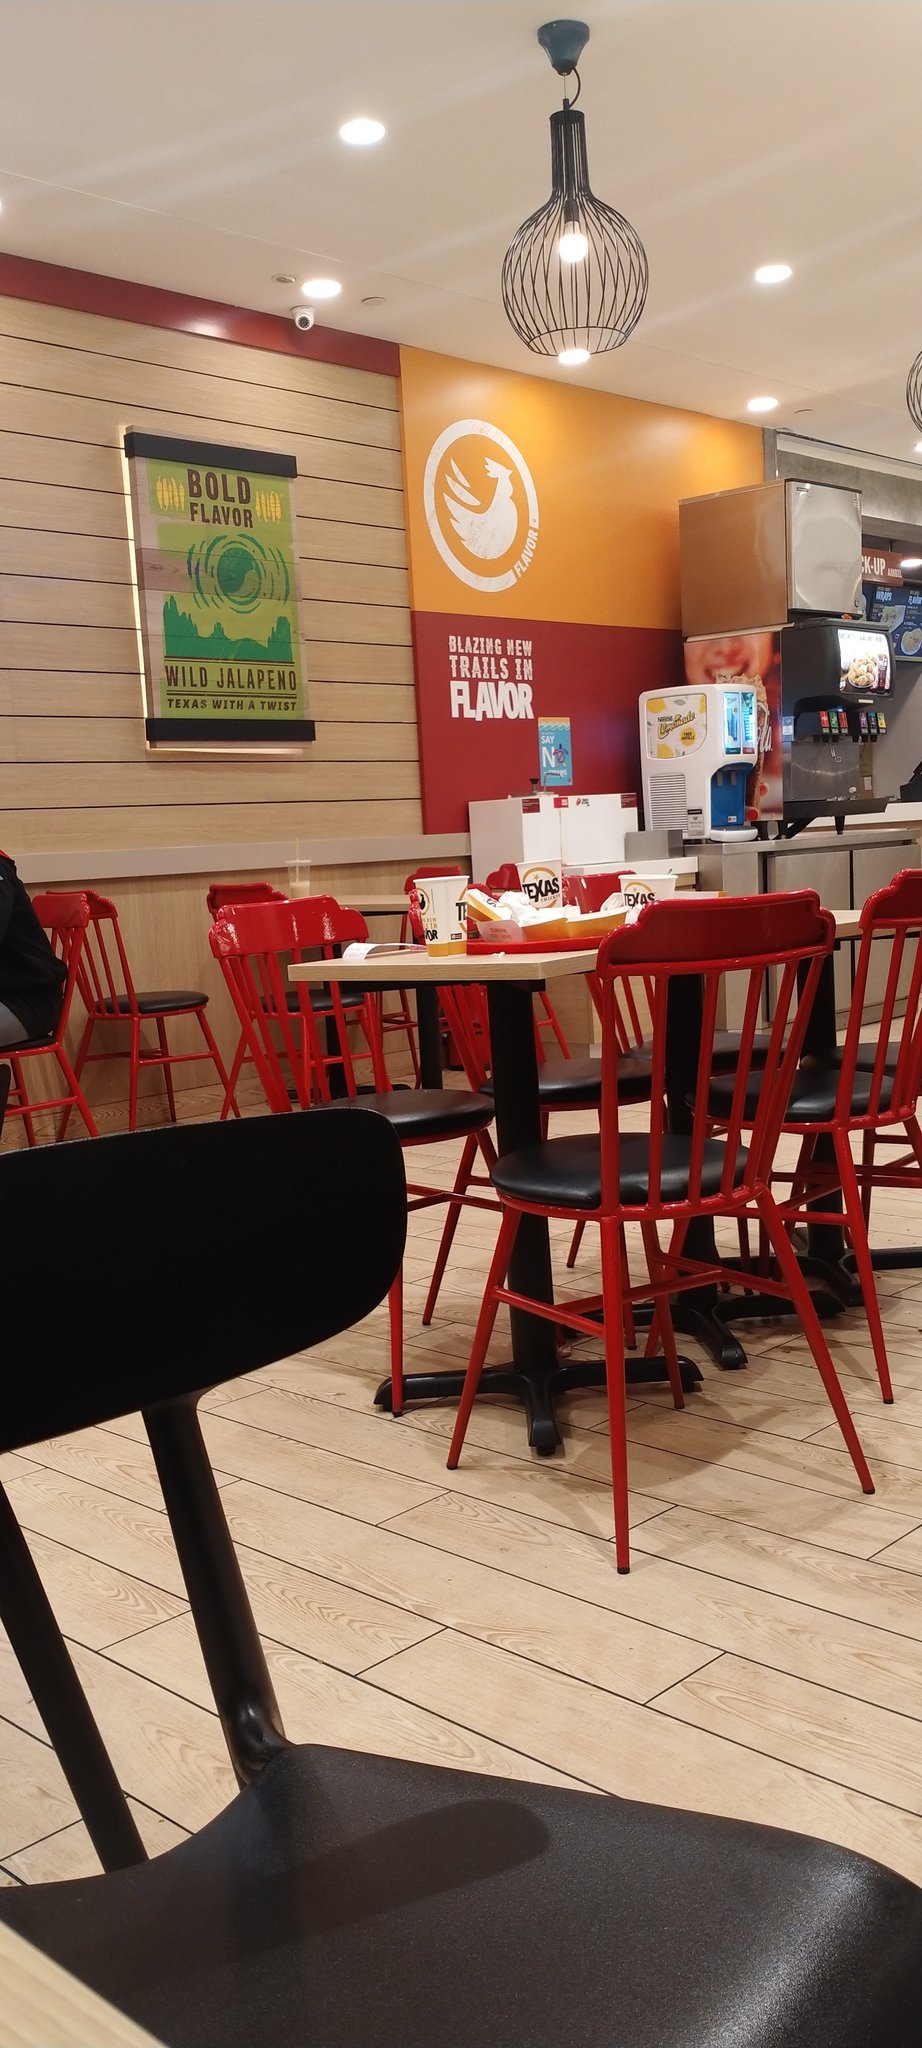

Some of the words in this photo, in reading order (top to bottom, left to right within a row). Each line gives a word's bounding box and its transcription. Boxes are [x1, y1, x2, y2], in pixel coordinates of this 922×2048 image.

[187, 468, 252, 505] BOLD
[189, 502, 254, 529] FLAVOR
[513, 528, 539, 578] FLAVOR
[448, 635, 503, 655] BLAZING
[506, 638, 533, 657] NEW
[165, 664, 208, 688] WILD
[216, 668, 297, 691] JALAPENO
[449, 655, 509, 680] TRAILS
[514, 658, 534, 680] IN
[167, 697, 208, 710] TEXAS
[212, 699, 244, 711] WITH
[248, 701, 256, 711] A
[260, 700, 297, 712] TWIST
[450, 679, 535, 721] FLAVOR
[541, 735, 555, 744] SAY
[522, 877, 560, 903] TEXAS
[623, 892, 656, 908] TEXAS
